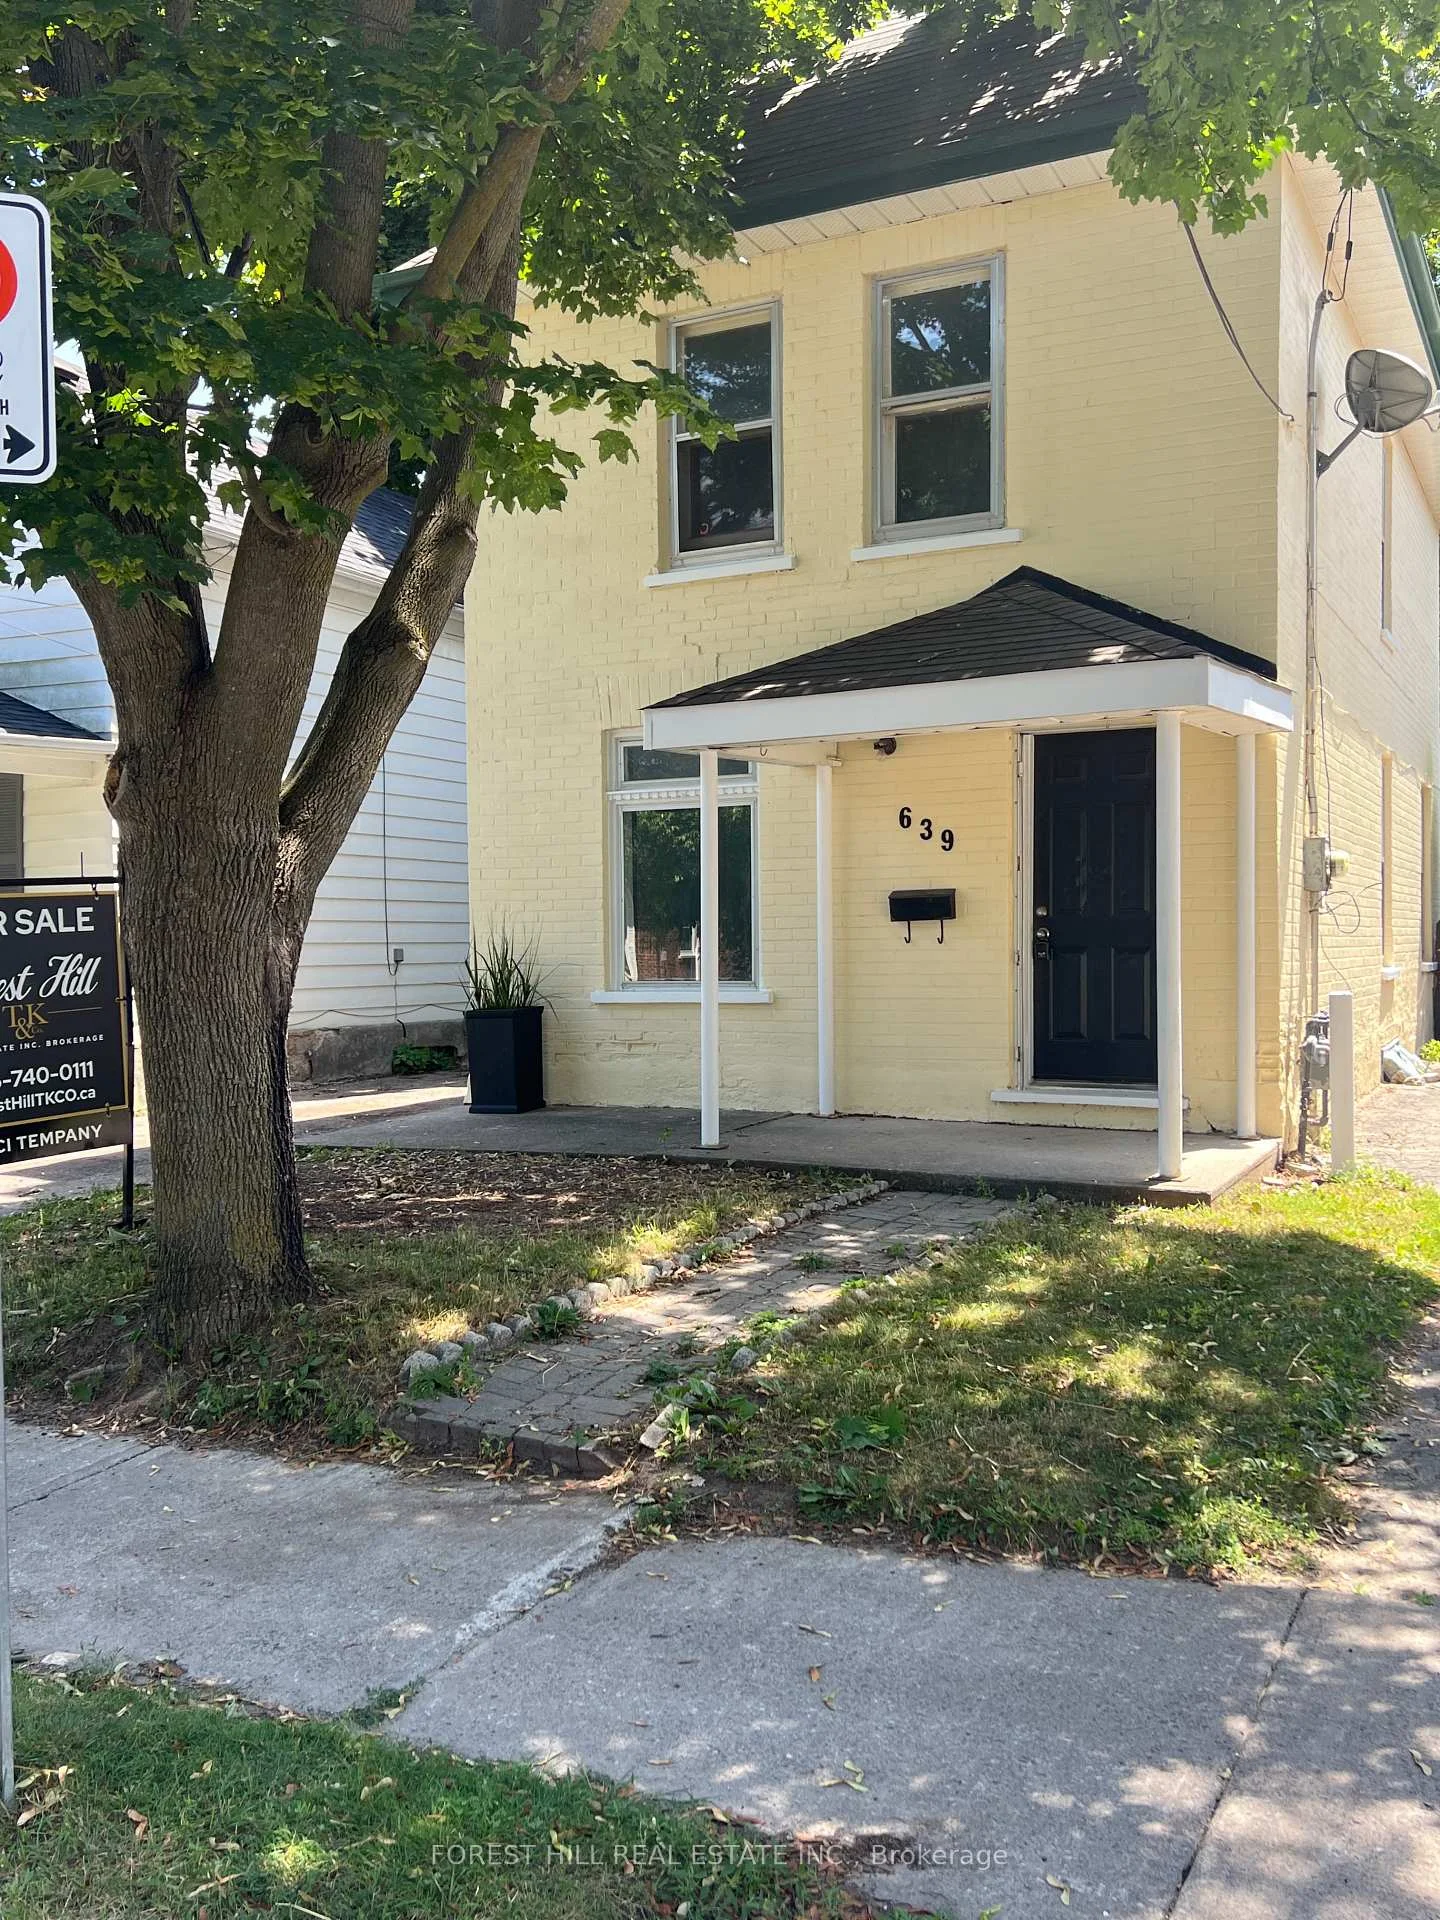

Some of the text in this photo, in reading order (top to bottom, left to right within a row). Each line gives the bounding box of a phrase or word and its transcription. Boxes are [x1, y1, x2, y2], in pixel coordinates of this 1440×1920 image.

[899, 807, 954, 851] 639
[15, 907, 95, 935] SALE
[39, 953, 102, 998] Hill
[20, 1041, 41, 1050] INC.
[45, 1034, 104, 1047] BROKERAGE
[0, 1060, 94, 1088] -740-0111
[16, 1124, 102, 1150] TEMPANY
